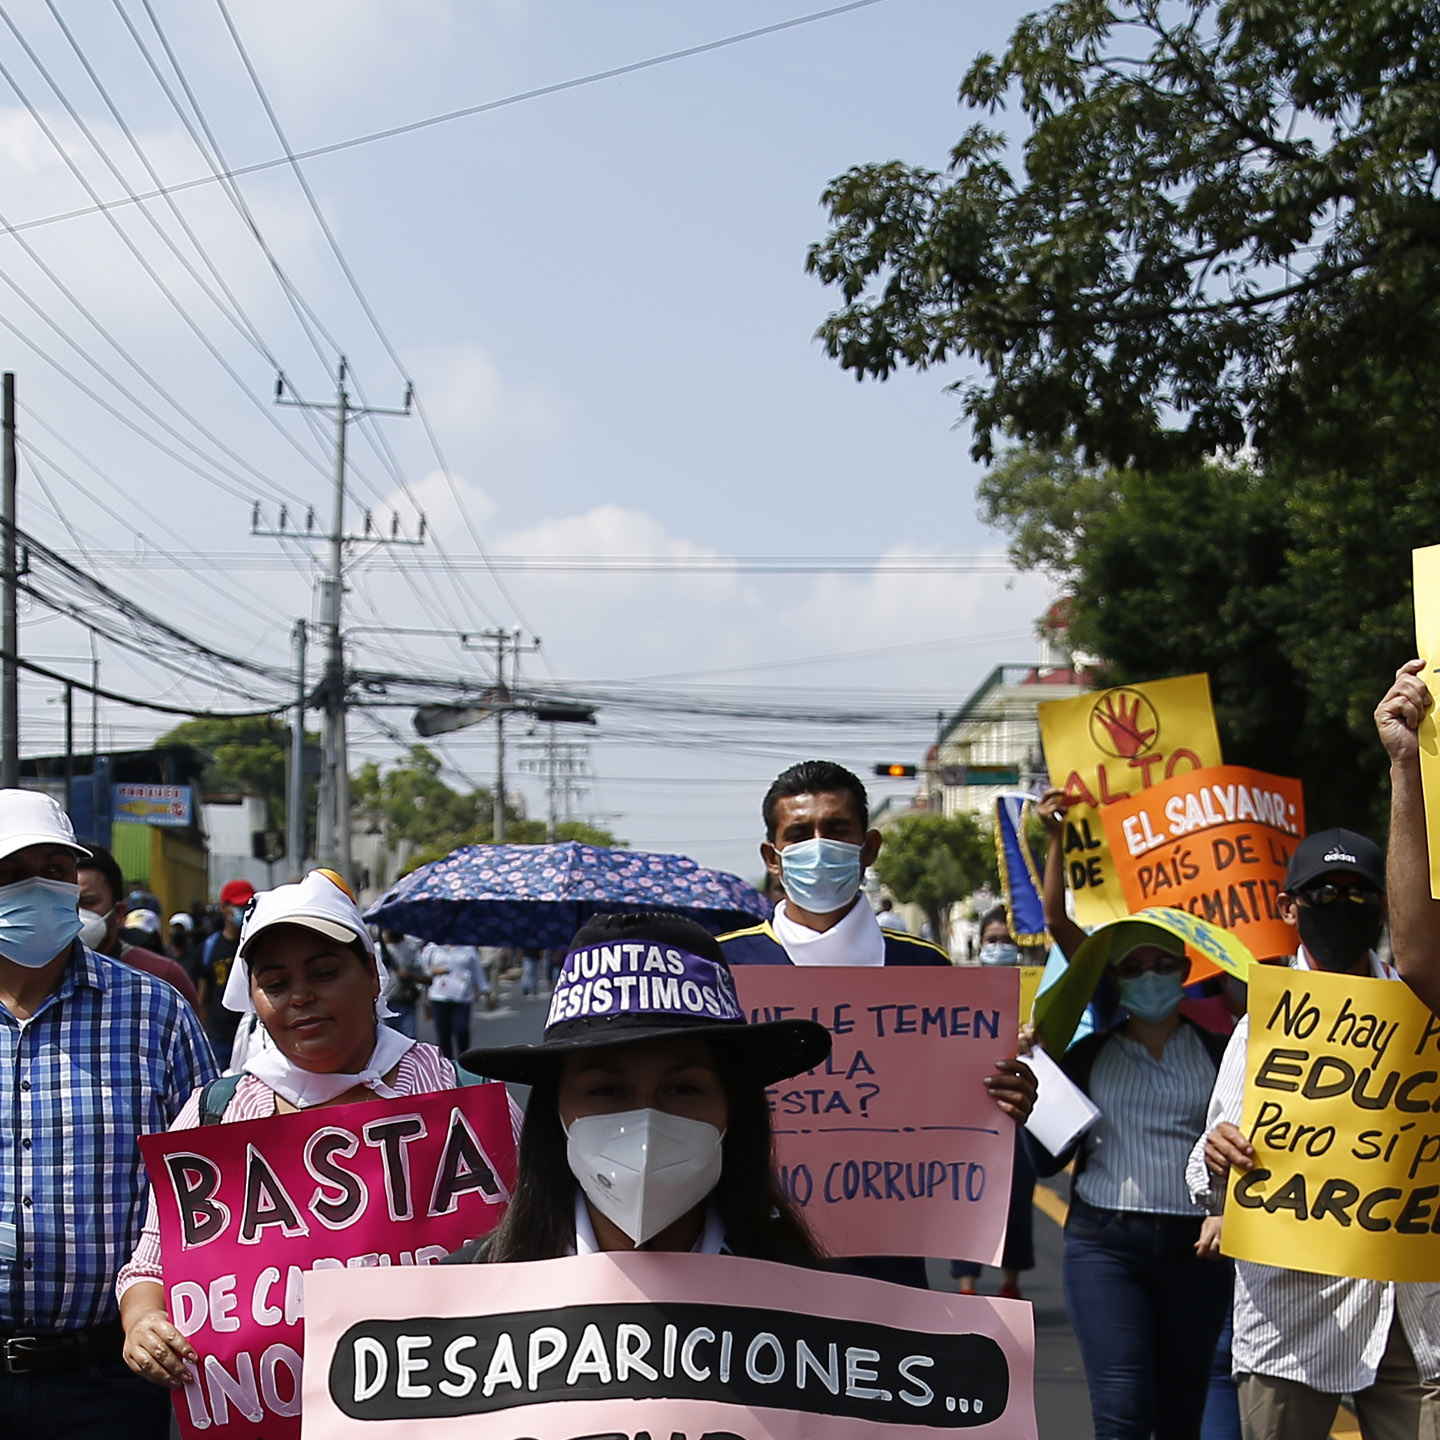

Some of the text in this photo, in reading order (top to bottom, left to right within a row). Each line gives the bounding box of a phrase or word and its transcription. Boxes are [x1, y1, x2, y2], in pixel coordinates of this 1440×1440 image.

[1062, 748, 1203, 808] ALTO
[1064, 818, 1101, 853] AL
[1122, 810, 1166, 857] EL
[1070, 856, 1104, 890] DE
[1136, 844, 1201, 899] PAÍS
[1212, 833, 1261, 871] DE
[567, 943, 685, 983] JUNTAS
[544, 976, 721, 1030] RESISTIMOS
[867, 1004, 1000, 1039] TEMEN
[1266, 989, 1321, 1040] No
[1326, 998, 1399, 1070] hay
[765, 1082, 881, 1119] ESTA?
[1249, 1101, 1336, 1158] Pero
[1352, 1121, 1417, 1163] sí
[162, 1106, 513, 1252] BASTA
[823, 1159, 987, 1203] CORRUPTO
[170, 1273, 241, 1338] DE
[181, 1342, 304, 1430] INO
[350, 1321, 985, 1416] DESAPARICIONES...
